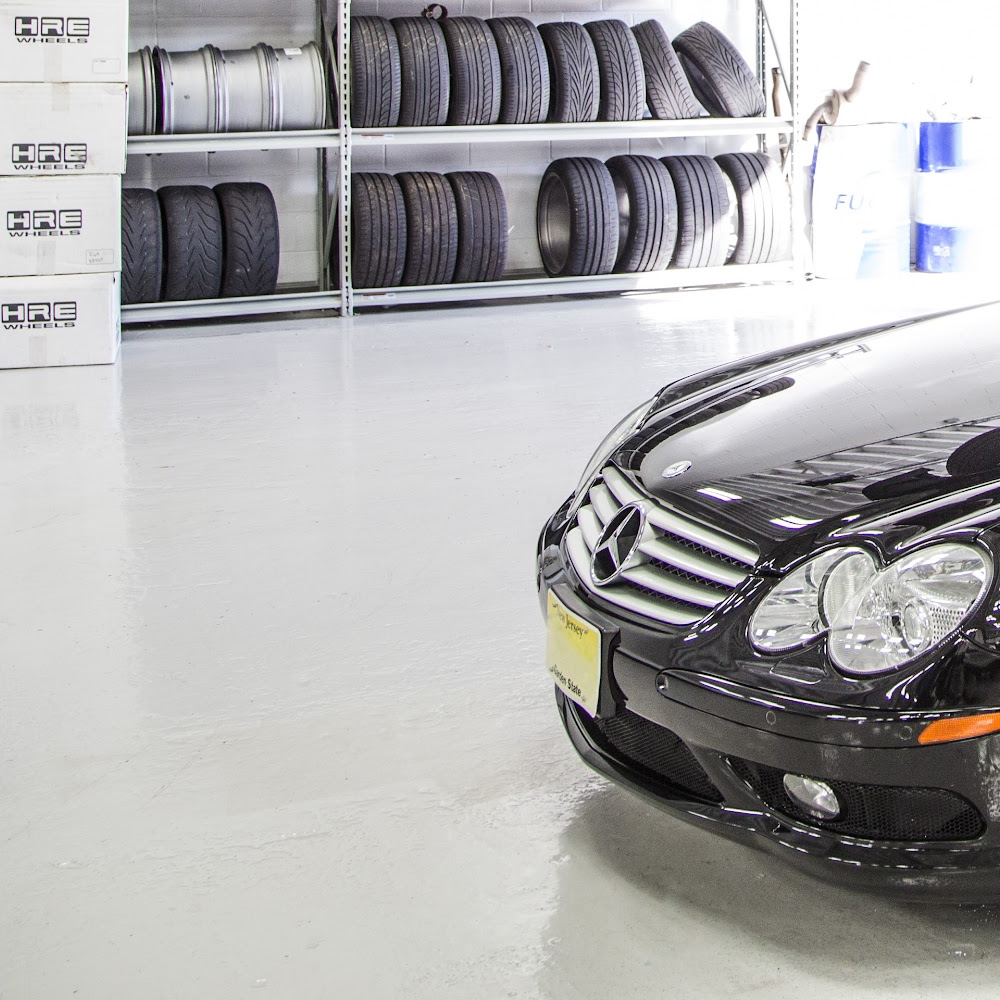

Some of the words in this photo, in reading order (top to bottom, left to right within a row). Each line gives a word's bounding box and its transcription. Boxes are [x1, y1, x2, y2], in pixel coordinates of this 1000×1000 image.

[14, 16, 90, 37] HRE
[12, 143, 87, 163] HRE
[6, 209, 82, 230] HRE
[1, 301, 77, 323] HRE
[3, 322, 75, 330] WHEELS
[567, 678, 582, 698] State
